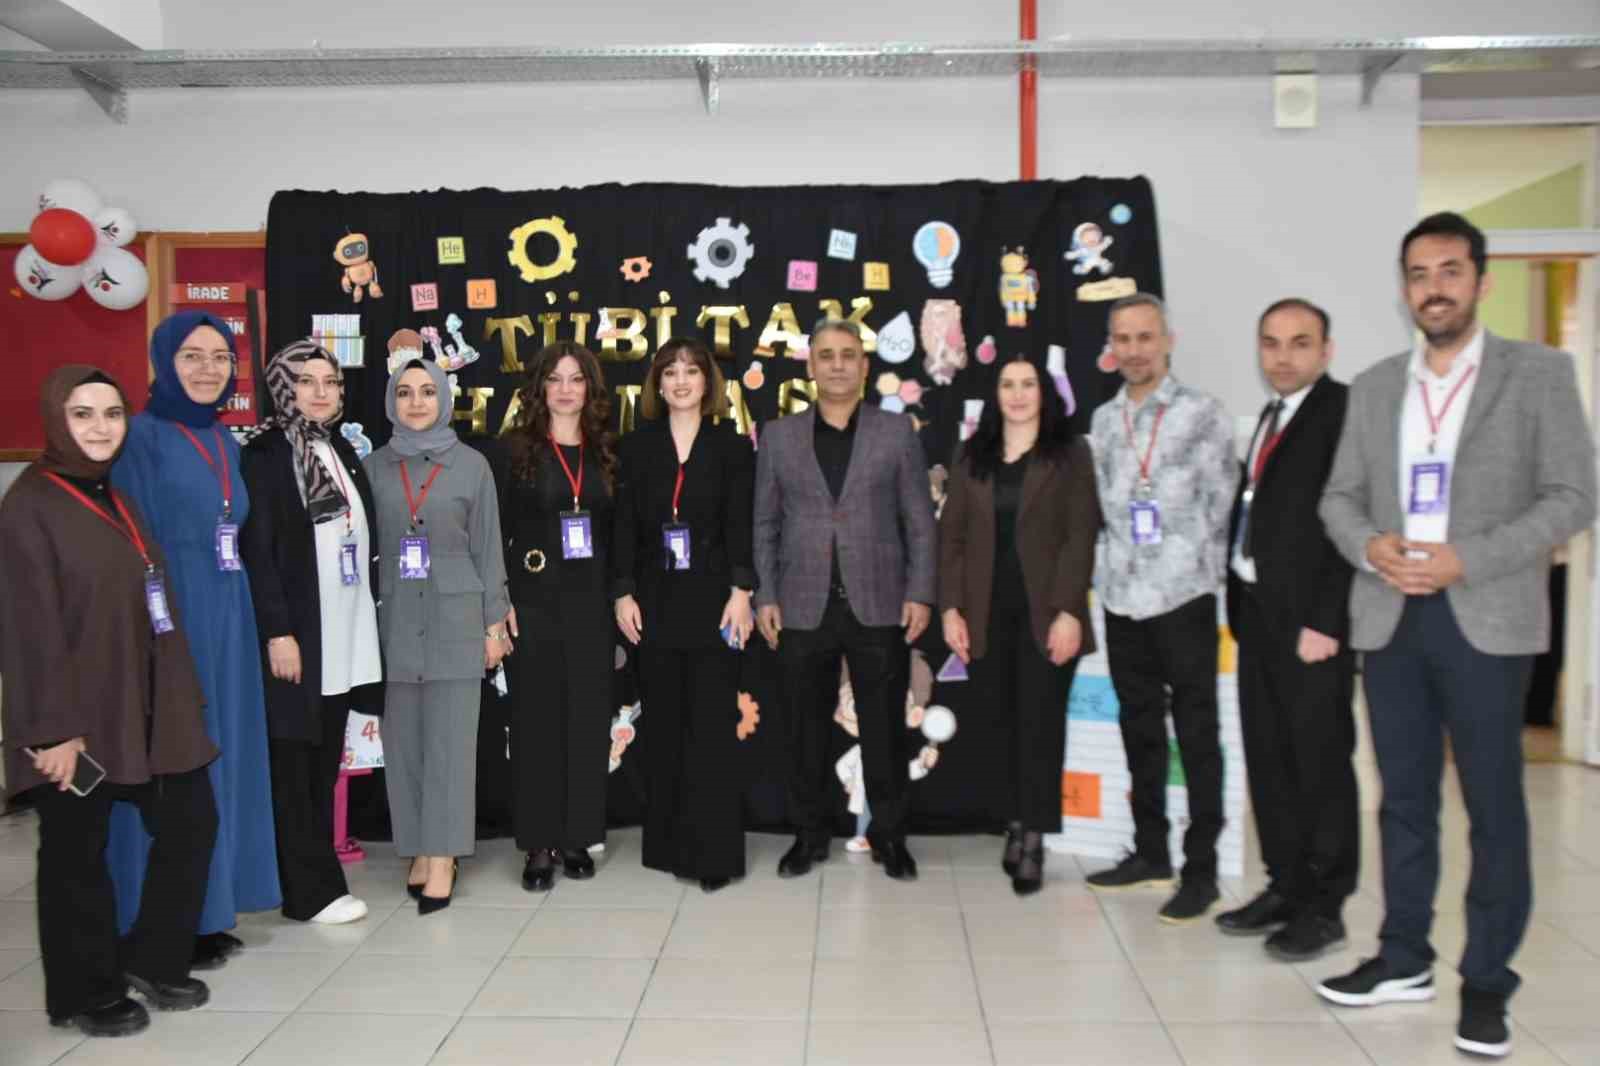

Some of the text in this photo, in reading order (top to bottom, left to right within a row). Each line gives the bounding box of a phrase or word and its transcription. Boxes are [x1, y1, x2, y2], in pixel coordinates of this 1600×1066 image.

[441, 241, 462, 256] He
[416, 287, 435, 301] Na
[476, 288, 488, 301] H
